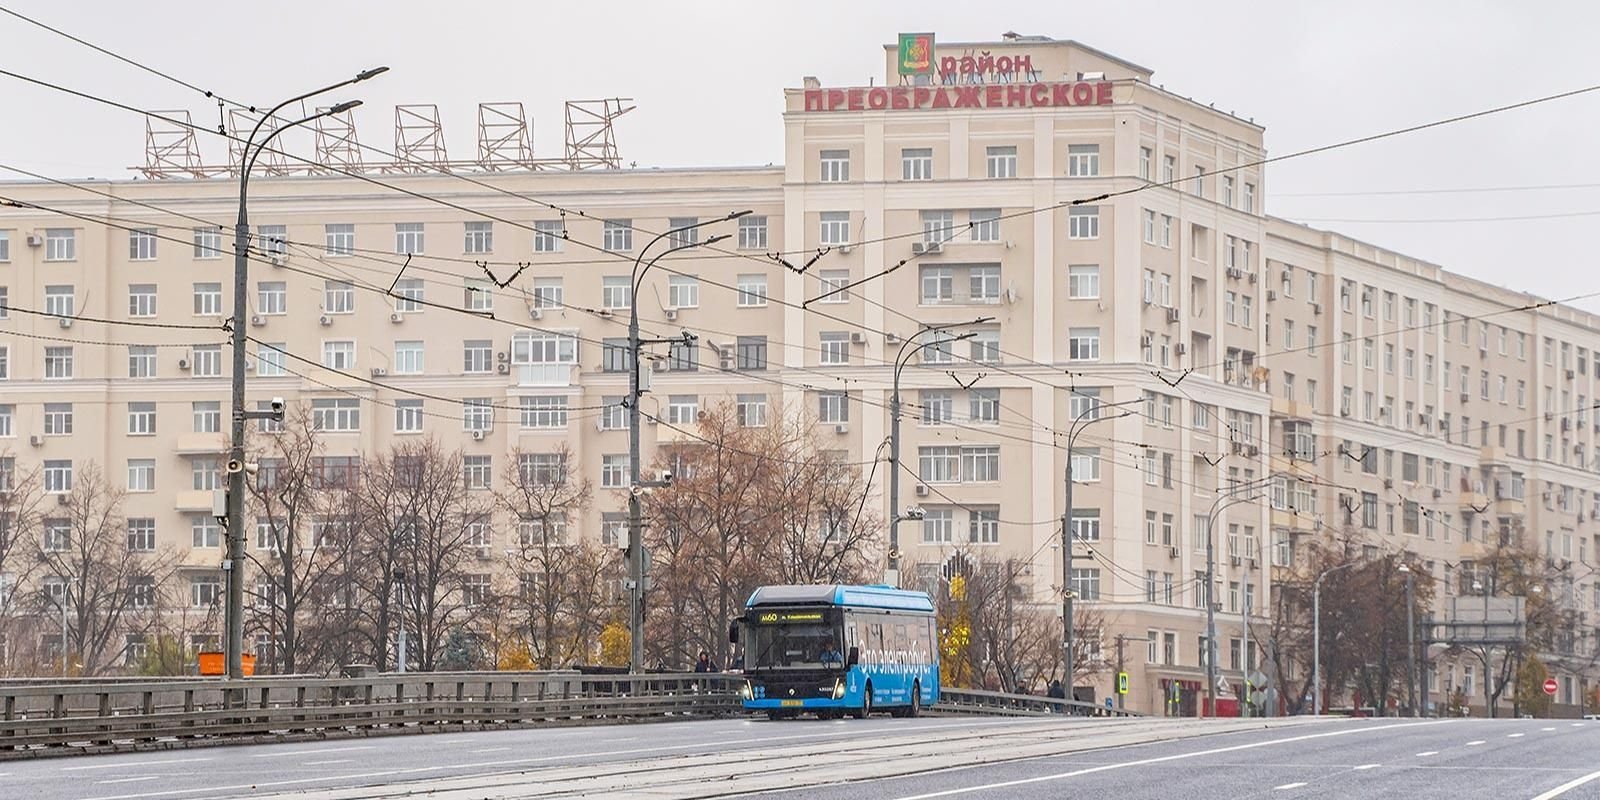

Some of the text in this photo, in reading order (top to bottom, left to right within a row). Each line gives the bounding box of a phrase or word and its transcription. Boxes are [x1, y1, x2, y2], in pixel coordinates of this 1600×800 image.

[941, 51, 1032, 80] район
[804, 82, 1114, 112] ПРЕОБРАЖЕНСКОЕ
[858, 639, 931, 683] Это электробус.
